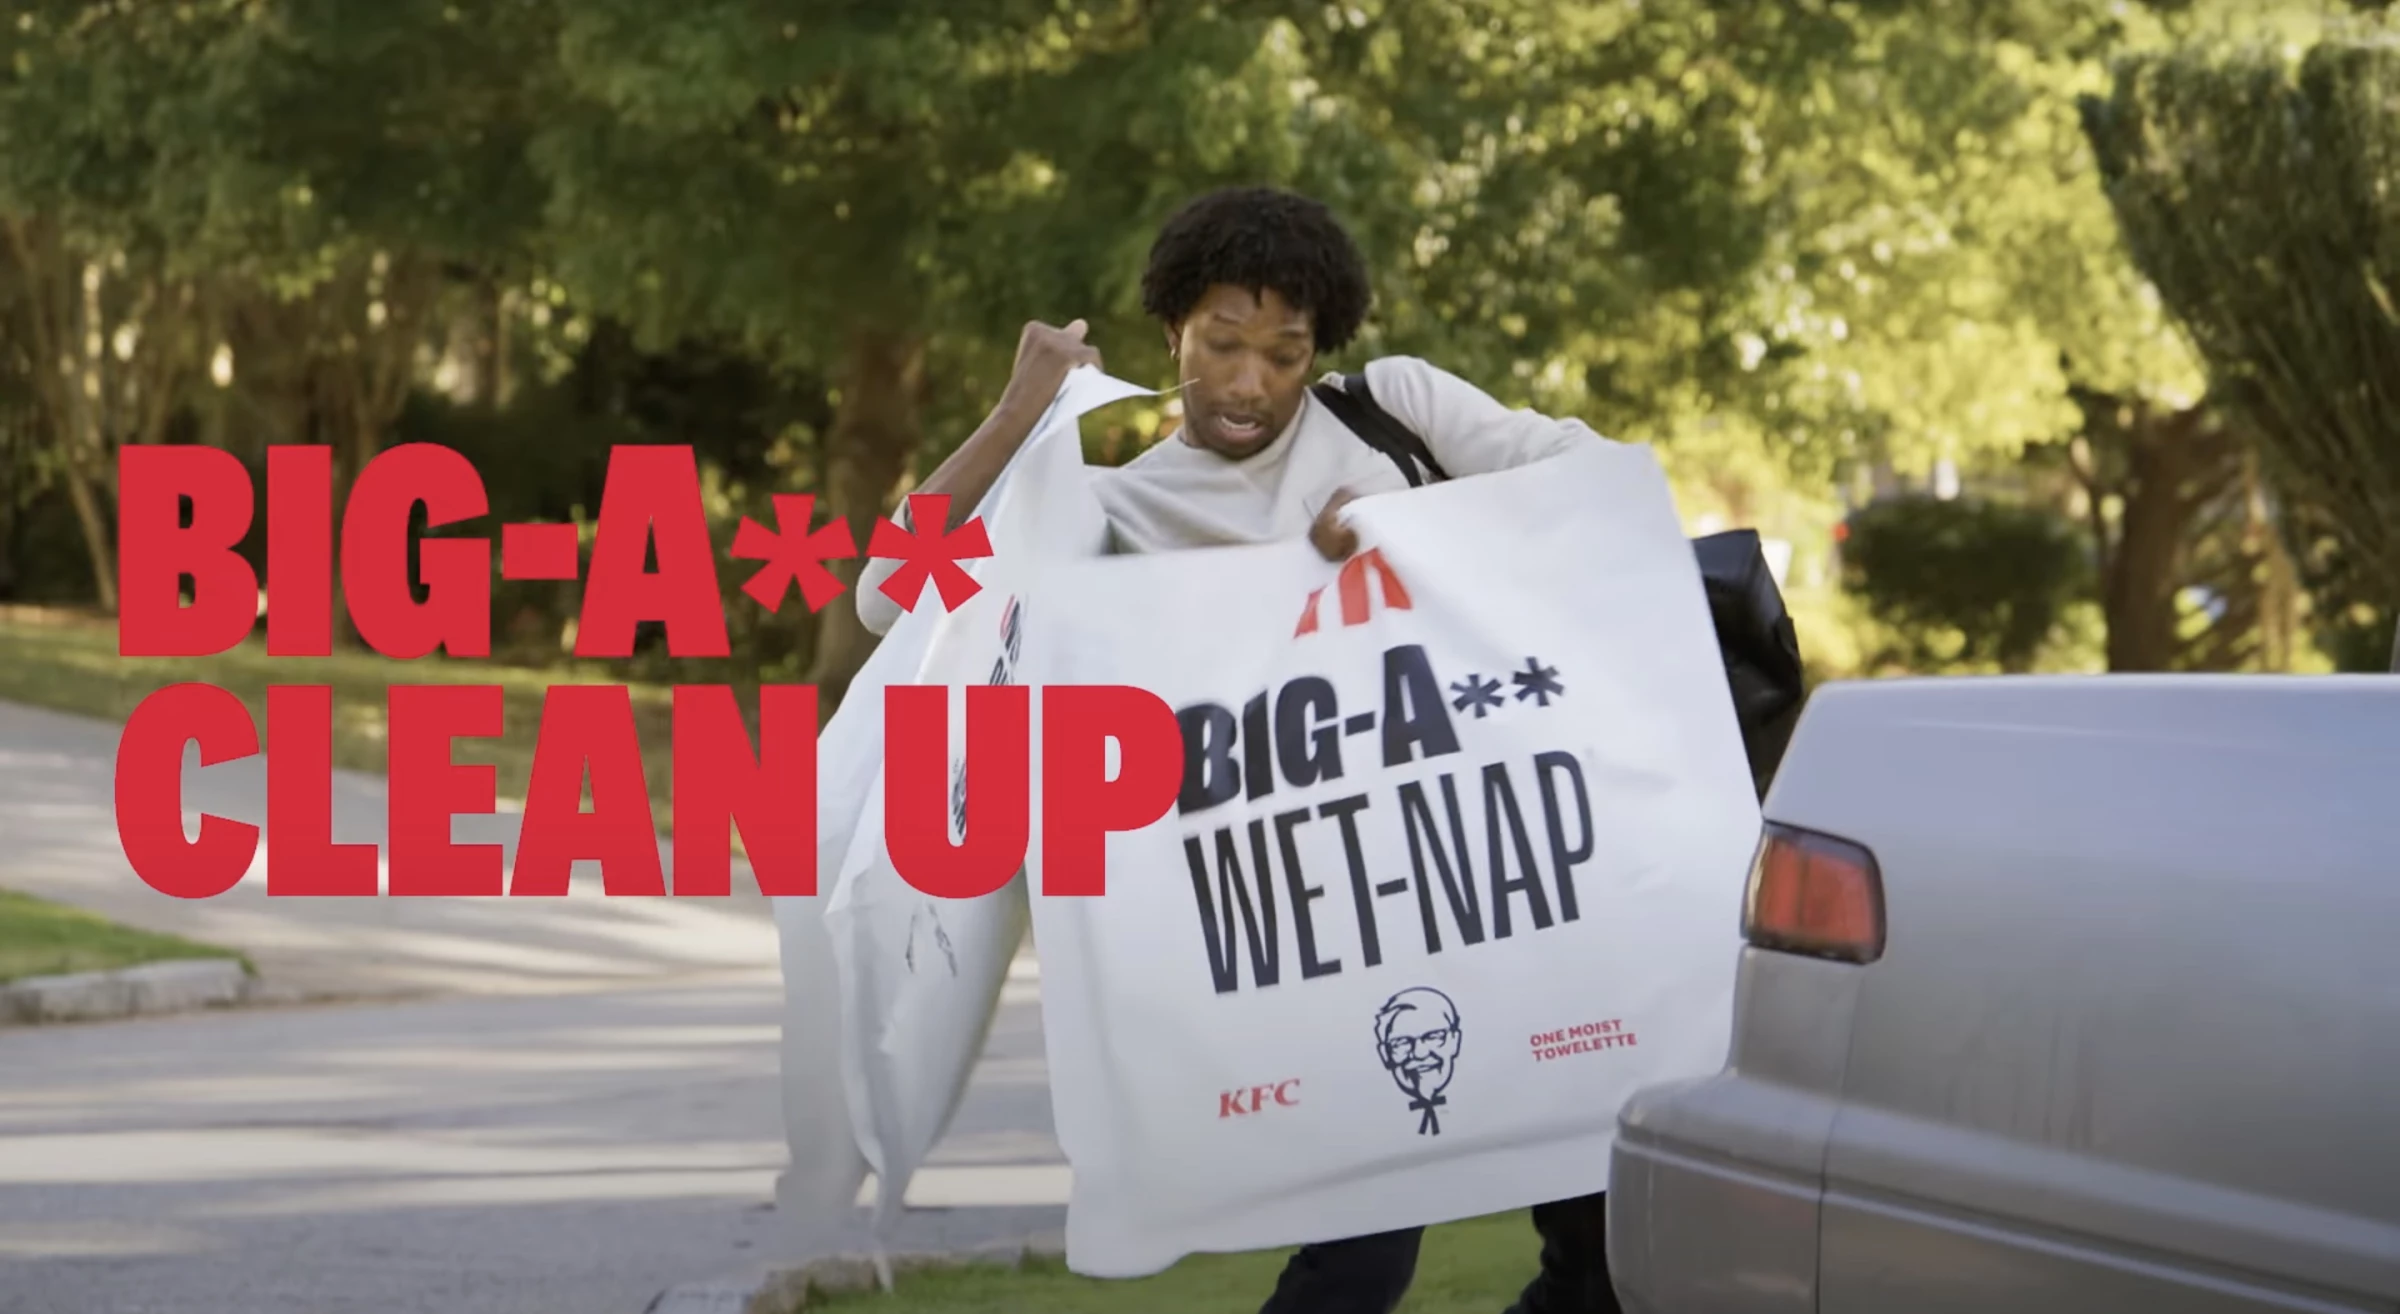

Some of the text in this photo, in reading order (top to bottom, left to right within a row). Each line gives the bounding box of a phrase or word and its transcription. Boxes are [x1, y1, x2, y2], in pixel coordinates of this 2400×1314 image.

[1183, 749, 1595, 994] WET-NAP
[1531, 1019, 1622, 1047] ONE MOIST
[1533, 1033, 1637, 1062] TOWELETTE
[1218, 1079, 1301, 1119] KFC
